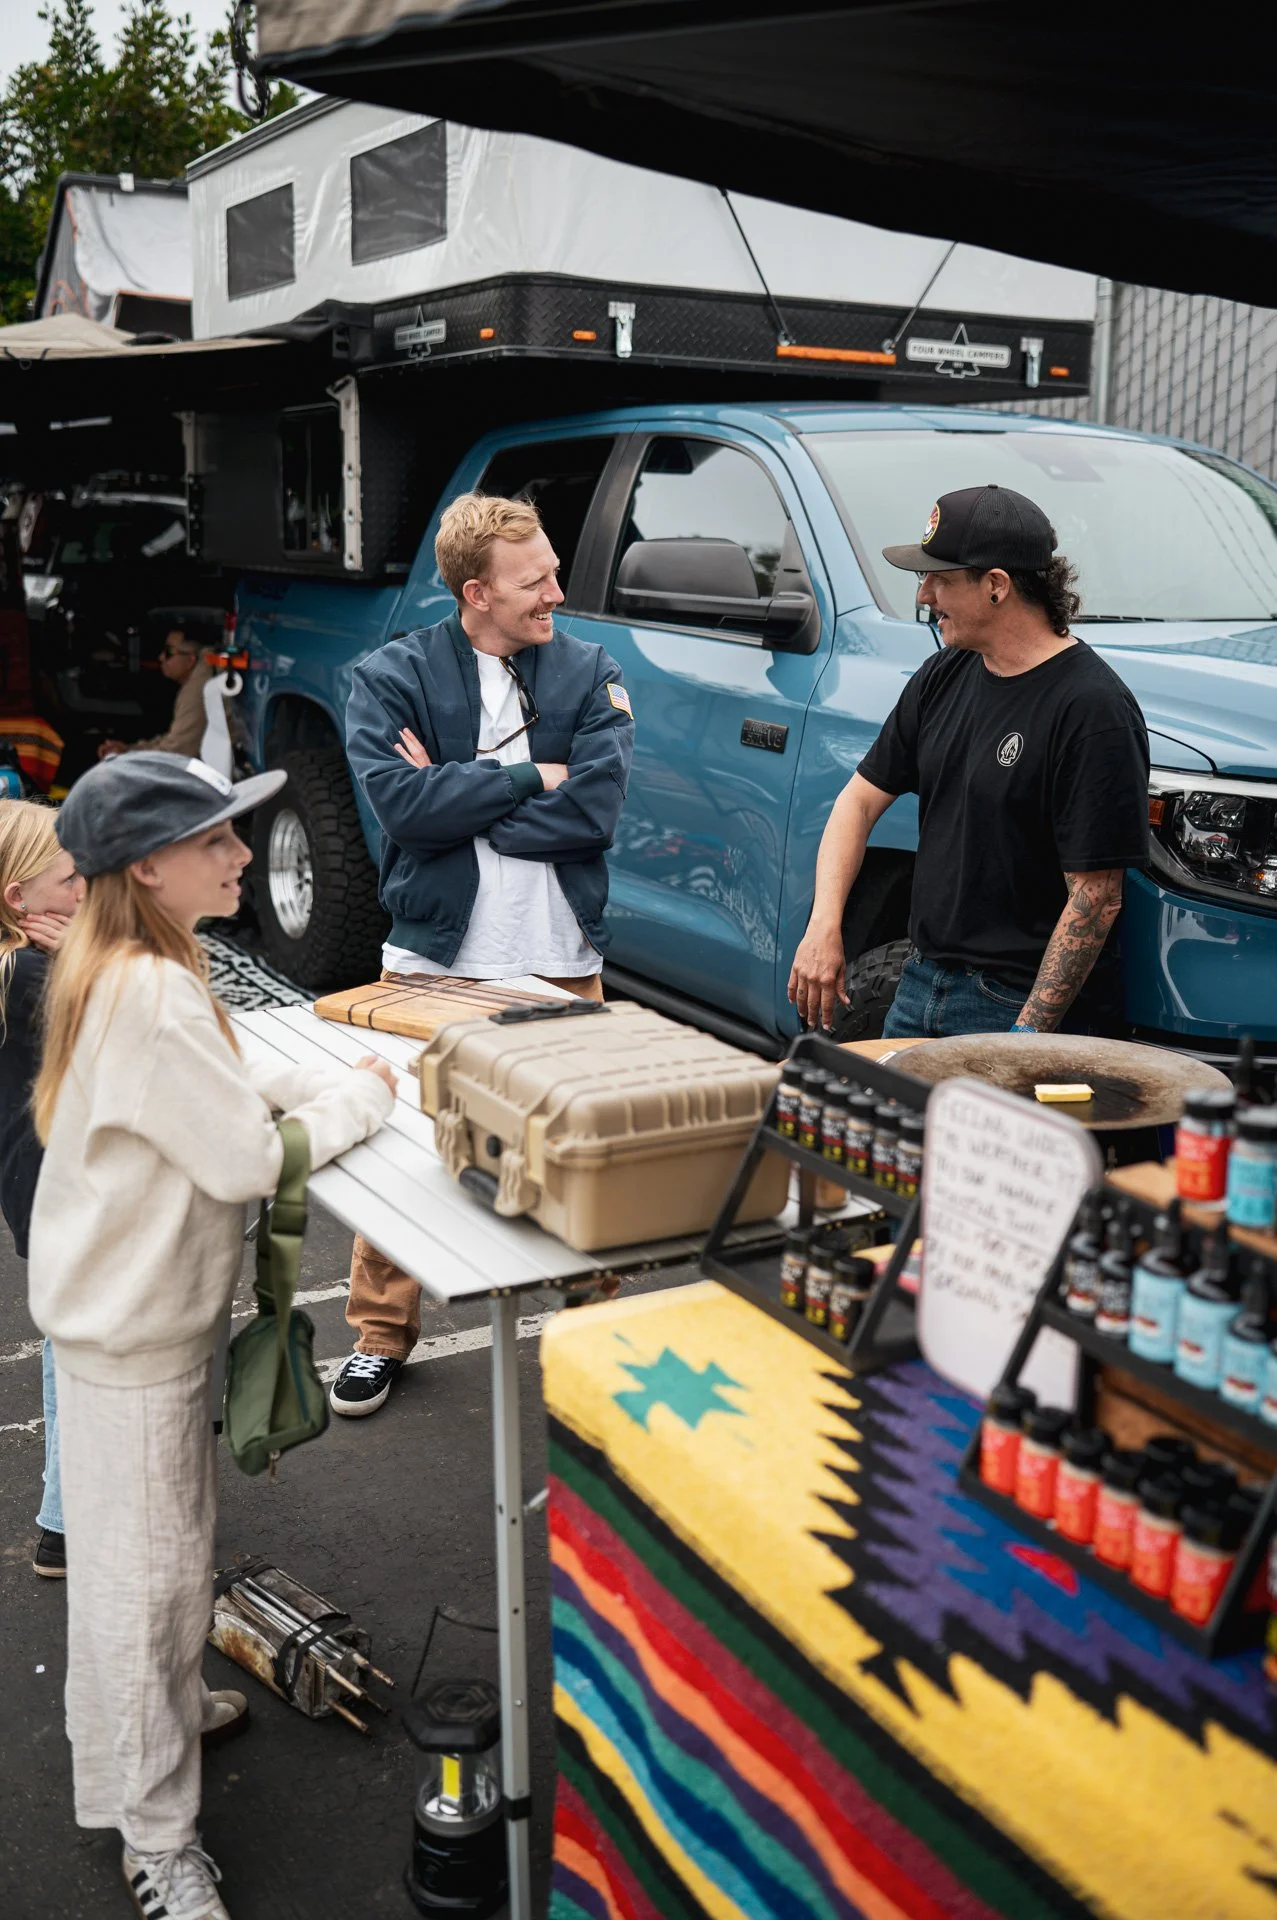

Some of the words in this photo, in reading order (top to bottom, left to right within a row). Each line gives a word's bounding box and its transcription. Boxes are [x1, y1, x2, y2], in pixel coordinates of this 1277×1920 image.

[912, 344, 934, 354] FOUR
[937, 346, 966, 358] WHEEL
[968, 350, 1005, 361] CAMPERS
